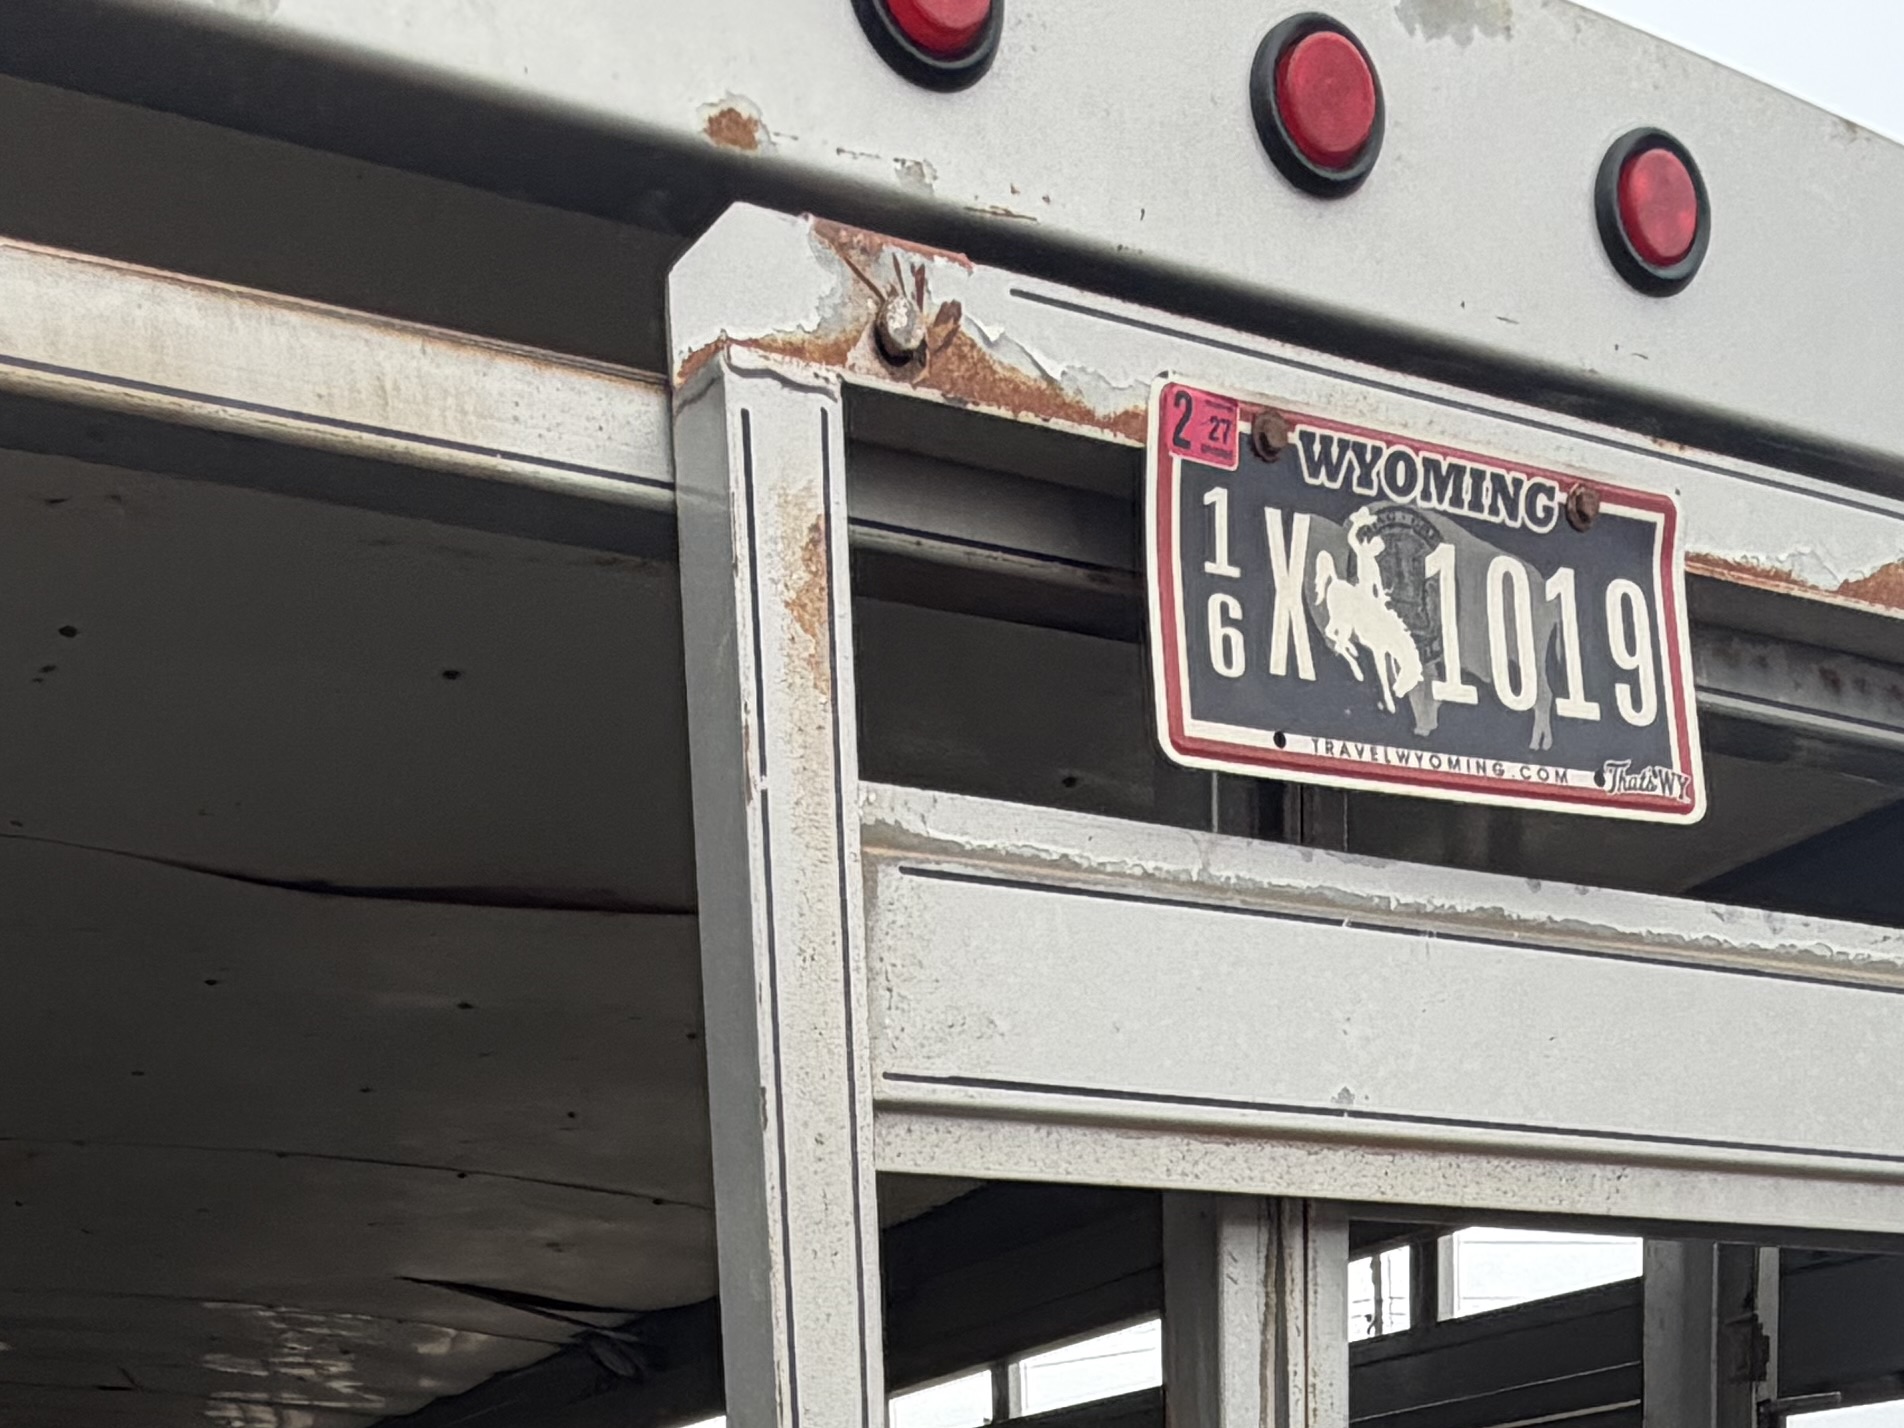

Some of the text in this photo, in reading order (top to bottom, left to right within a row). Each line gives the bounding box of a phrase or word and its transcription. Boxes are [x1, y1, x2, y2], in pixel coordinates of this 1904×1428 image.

[1173, 390, 1192, 449] 2
[1298, 431, 1559, 530] WYOMING
[1264, 507, 1659, 727] X 1019
[1311, 737, 1569, 785] TRAVELWYOMING.COM
